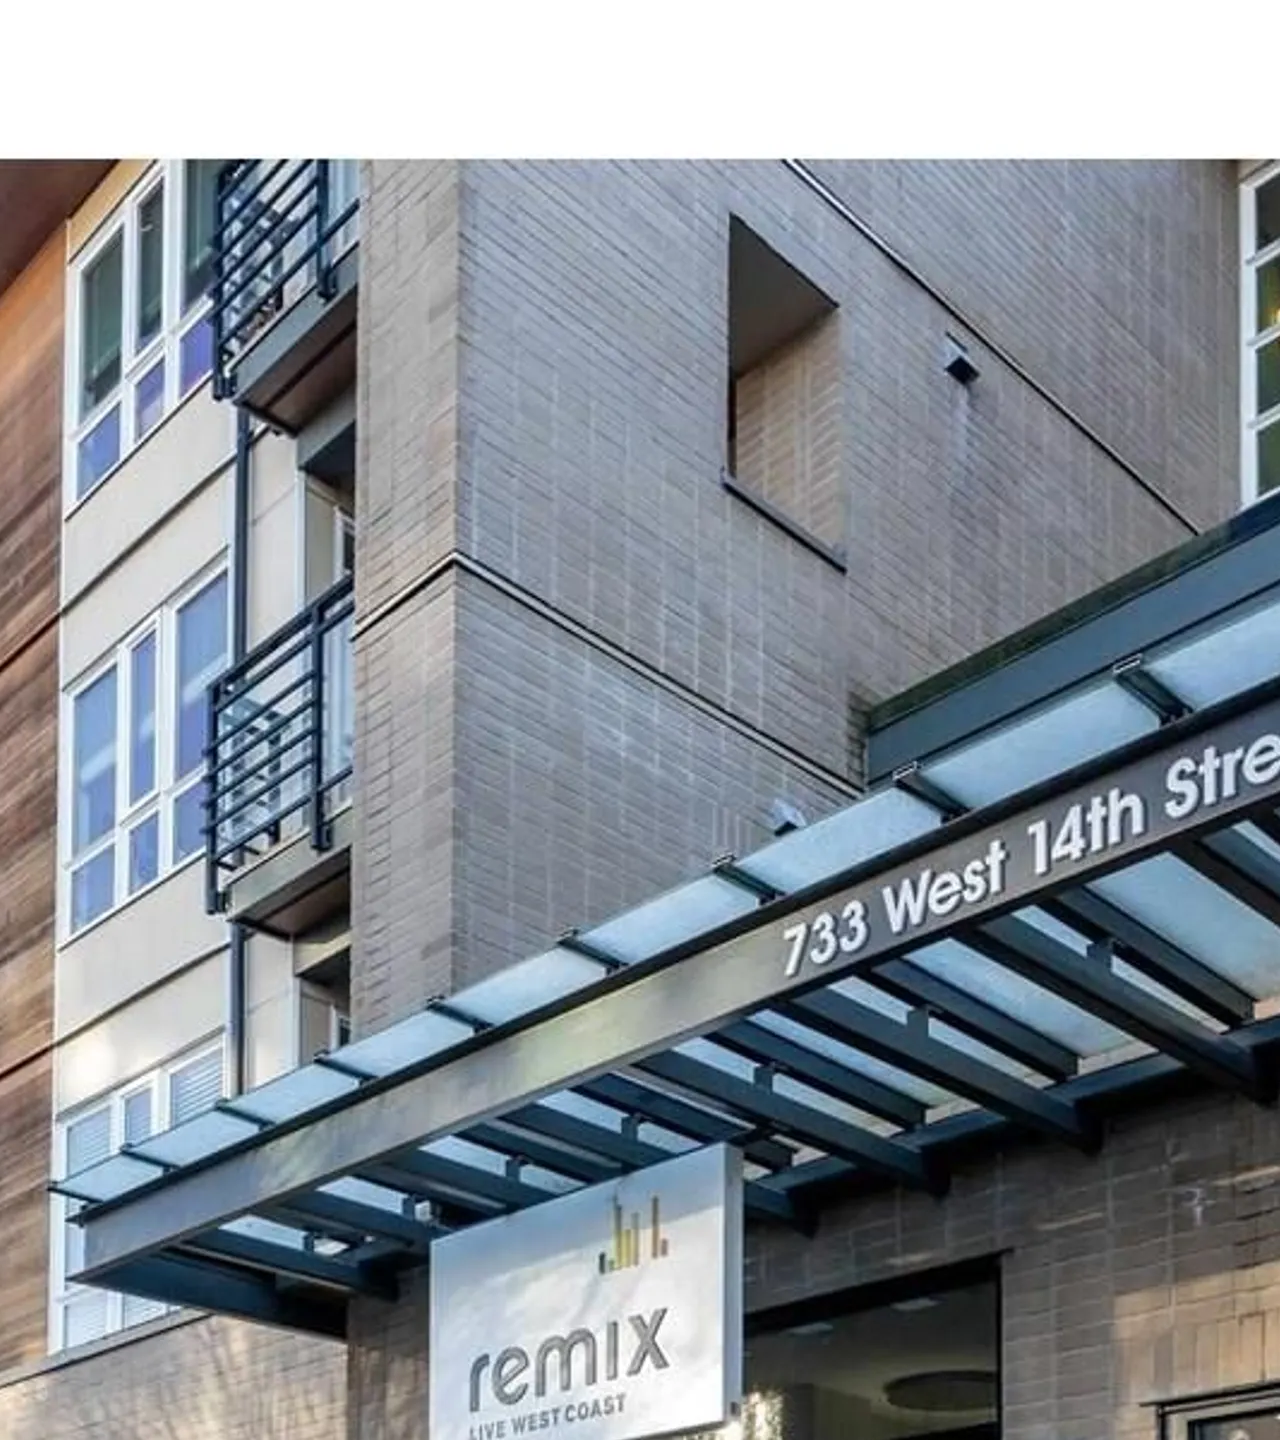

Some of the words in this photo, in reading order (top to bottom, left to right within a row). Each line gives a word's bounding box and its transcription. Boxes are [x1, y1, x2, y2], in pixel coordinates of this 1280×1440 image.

[783, 899, 869, 978] 733
[883, 839, 1009, 934] West
[1027, 787, 1145, 874] 14th
[469, 1307, 671, 1413] remix
[512, 1408, 561, 1435] WEST
[564, 1394, 627, 1423] COAST
